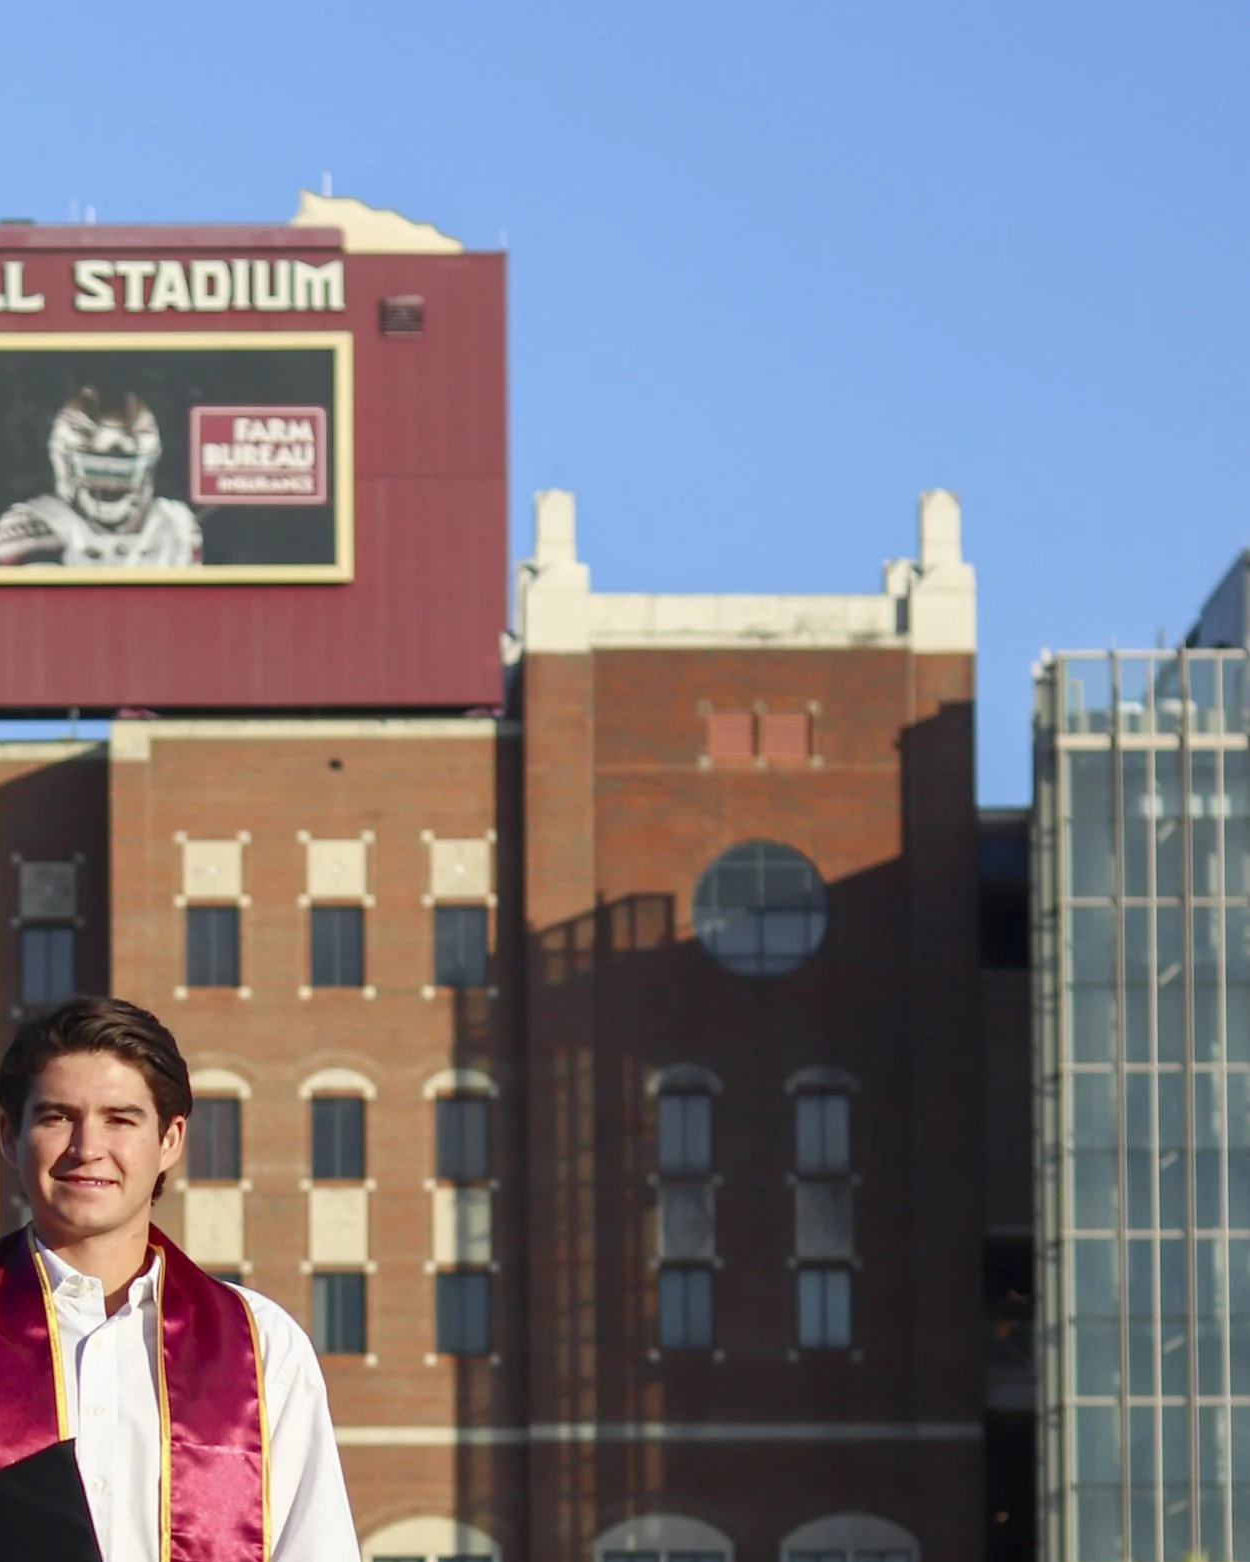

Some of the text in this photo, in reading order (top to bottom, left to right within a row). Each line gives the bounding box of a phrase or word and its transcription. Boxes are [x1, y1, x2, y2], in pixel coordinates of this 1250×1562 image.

[75, 259, 346, 311] STADIUM
[233, 417, 315, 442] FARM
[202, 442, 316, 468] BUREAU
